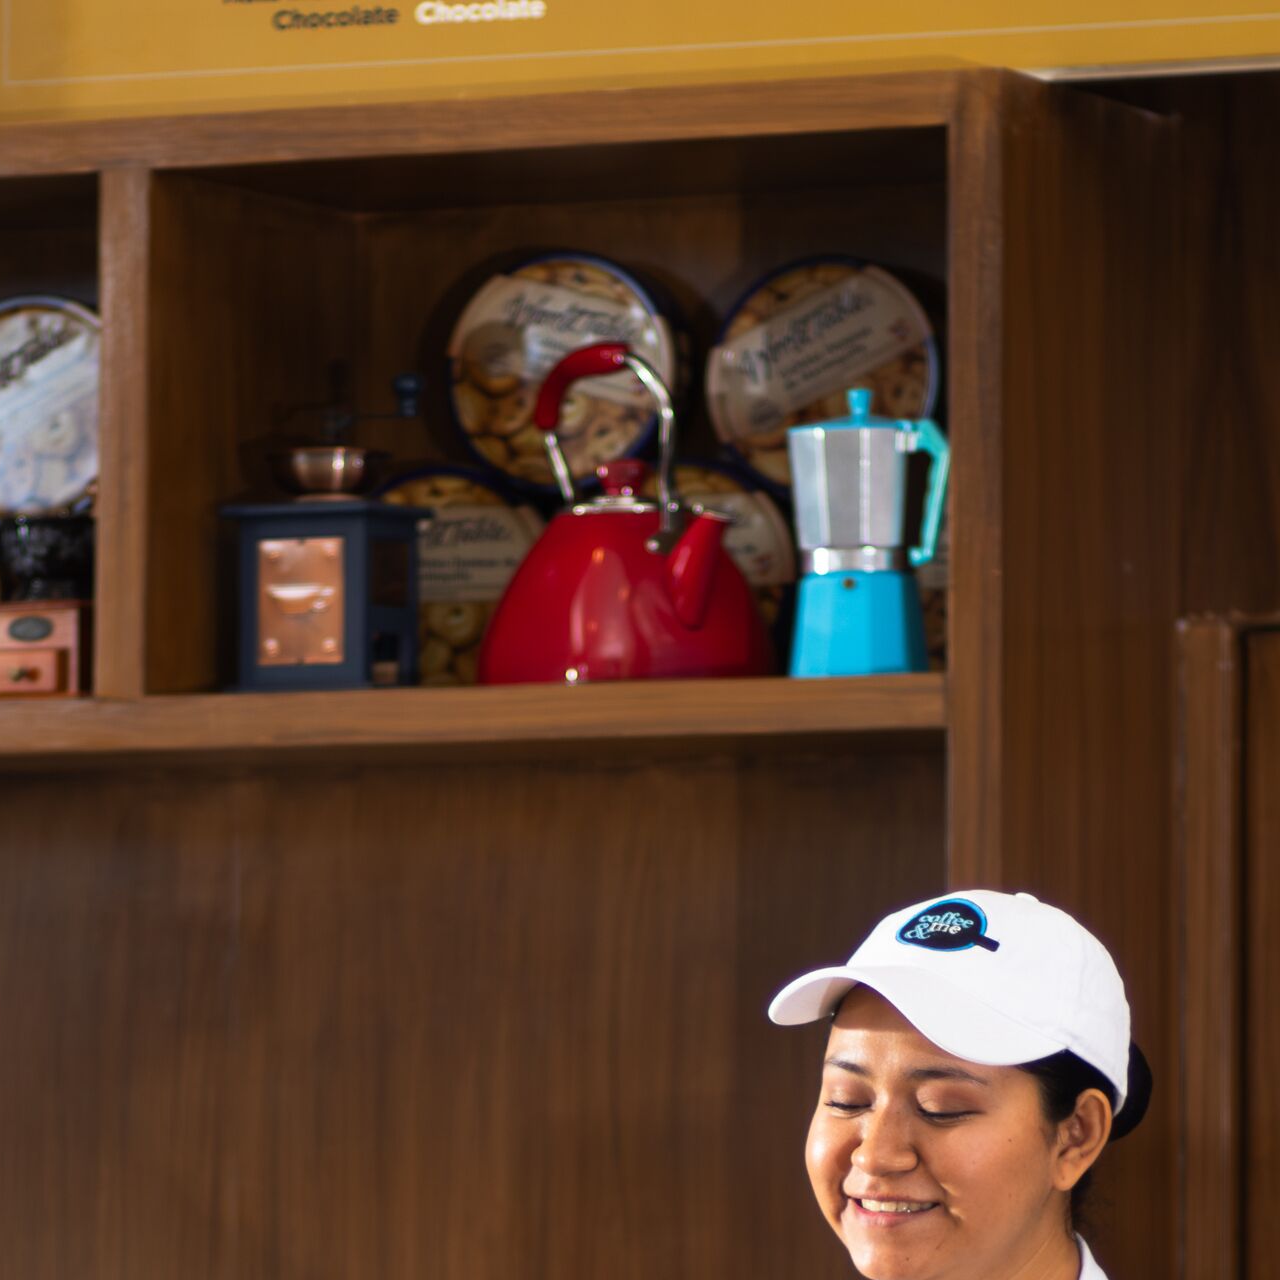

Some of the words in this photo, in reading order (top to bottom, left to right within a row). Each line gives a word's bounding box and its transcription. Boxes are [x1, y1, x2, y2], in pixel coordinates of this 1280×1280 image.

[273, 6, 399, 30] Chocolate
[415, 0, 546, 24] Chocolate
[919, 911, 974, 928] coffee
[904, 922, 931, 939] &
[929, 922, 962, 934] me
